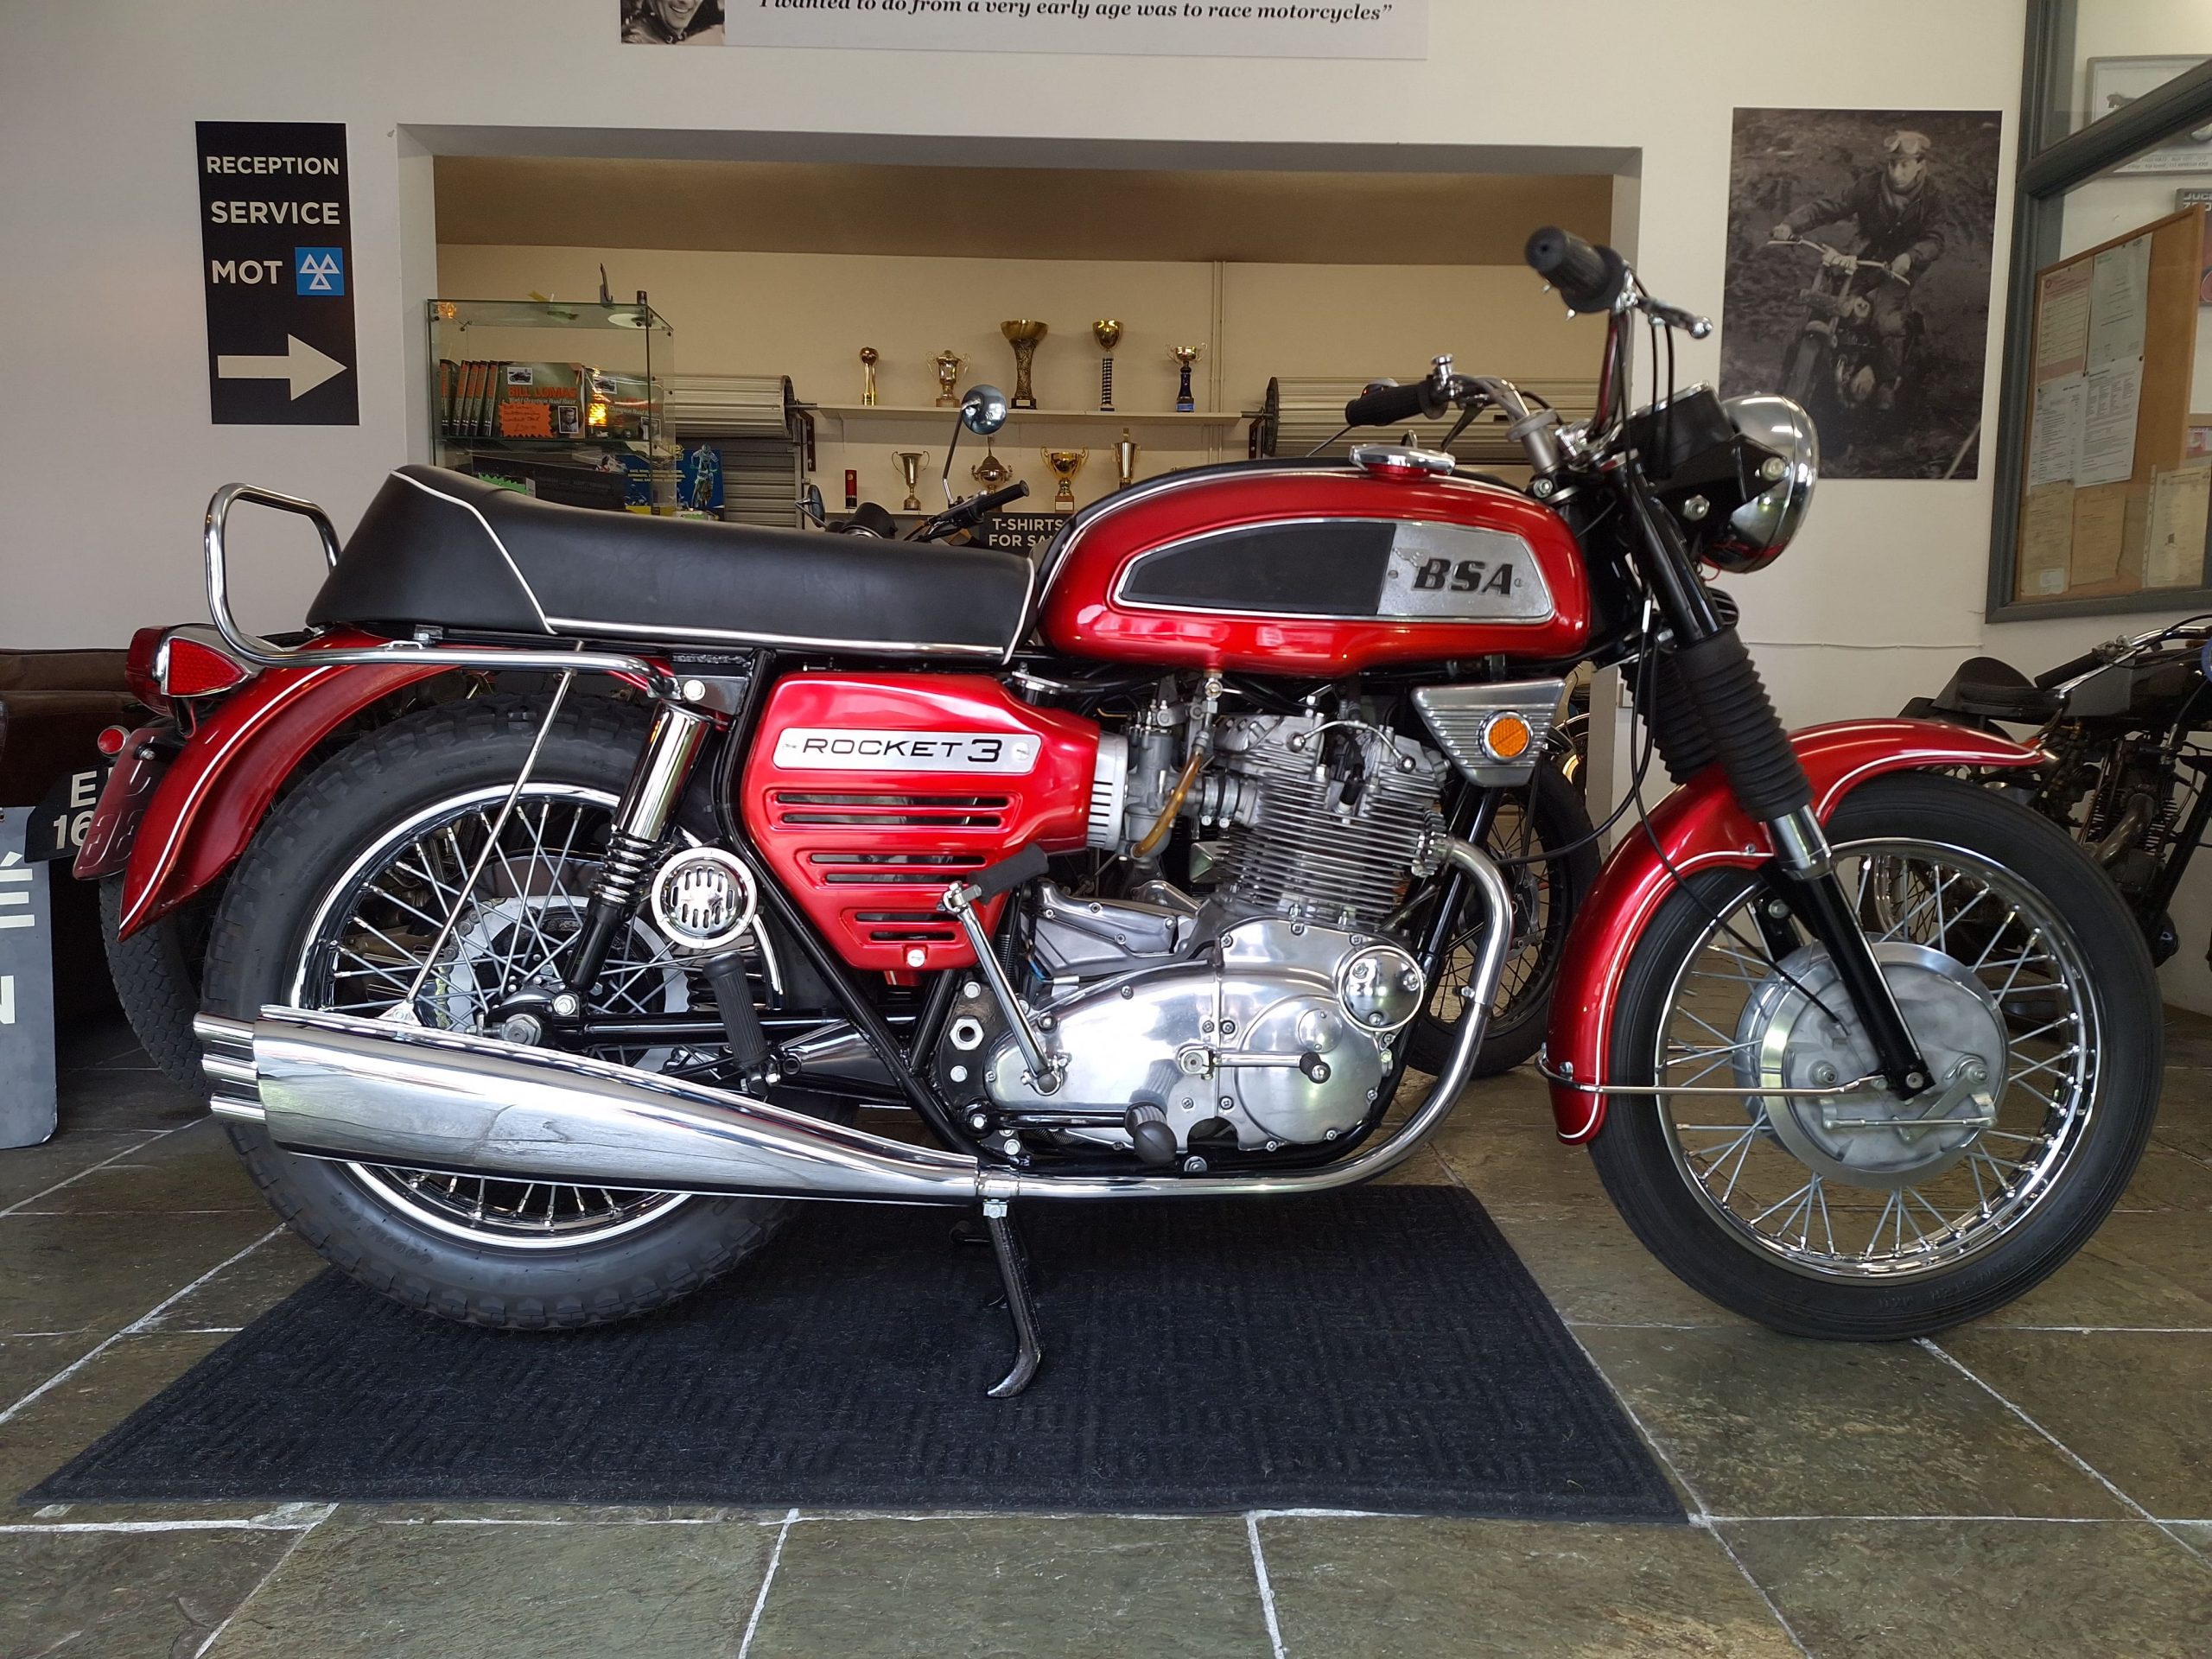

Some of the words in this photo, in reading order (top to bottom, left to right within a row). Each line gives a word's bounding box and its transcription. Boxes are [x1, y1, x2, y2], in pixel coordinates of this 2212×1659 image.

[774, 0, 850, 10] wanted
[856, 0, 876, 10] to
[881, 0, 907, 11] do
[907, 0, 962, 16] from
[967, 1, 980, 13] a
[986, 1, 1031, 18] very
[1036, 0, 1090, 19] early
[1095, 3, 1132, 20] age
[1137, 4, 1178, 16] was
[1183, 3, 1203, 17] to
[1208, 6, 1252, 18] race
[207, 156, 340, 175] RECEPTION
[211, 200, 340, 225] SERVICE
[212, 259, 283, 285] MOT
[508, 386, 531, 397] BILL
[992, 518, 1064, 531] T-SHIRTS
[988, 534, 1022, 547] FOR
[1411, 557, 1514, 596] BSA
